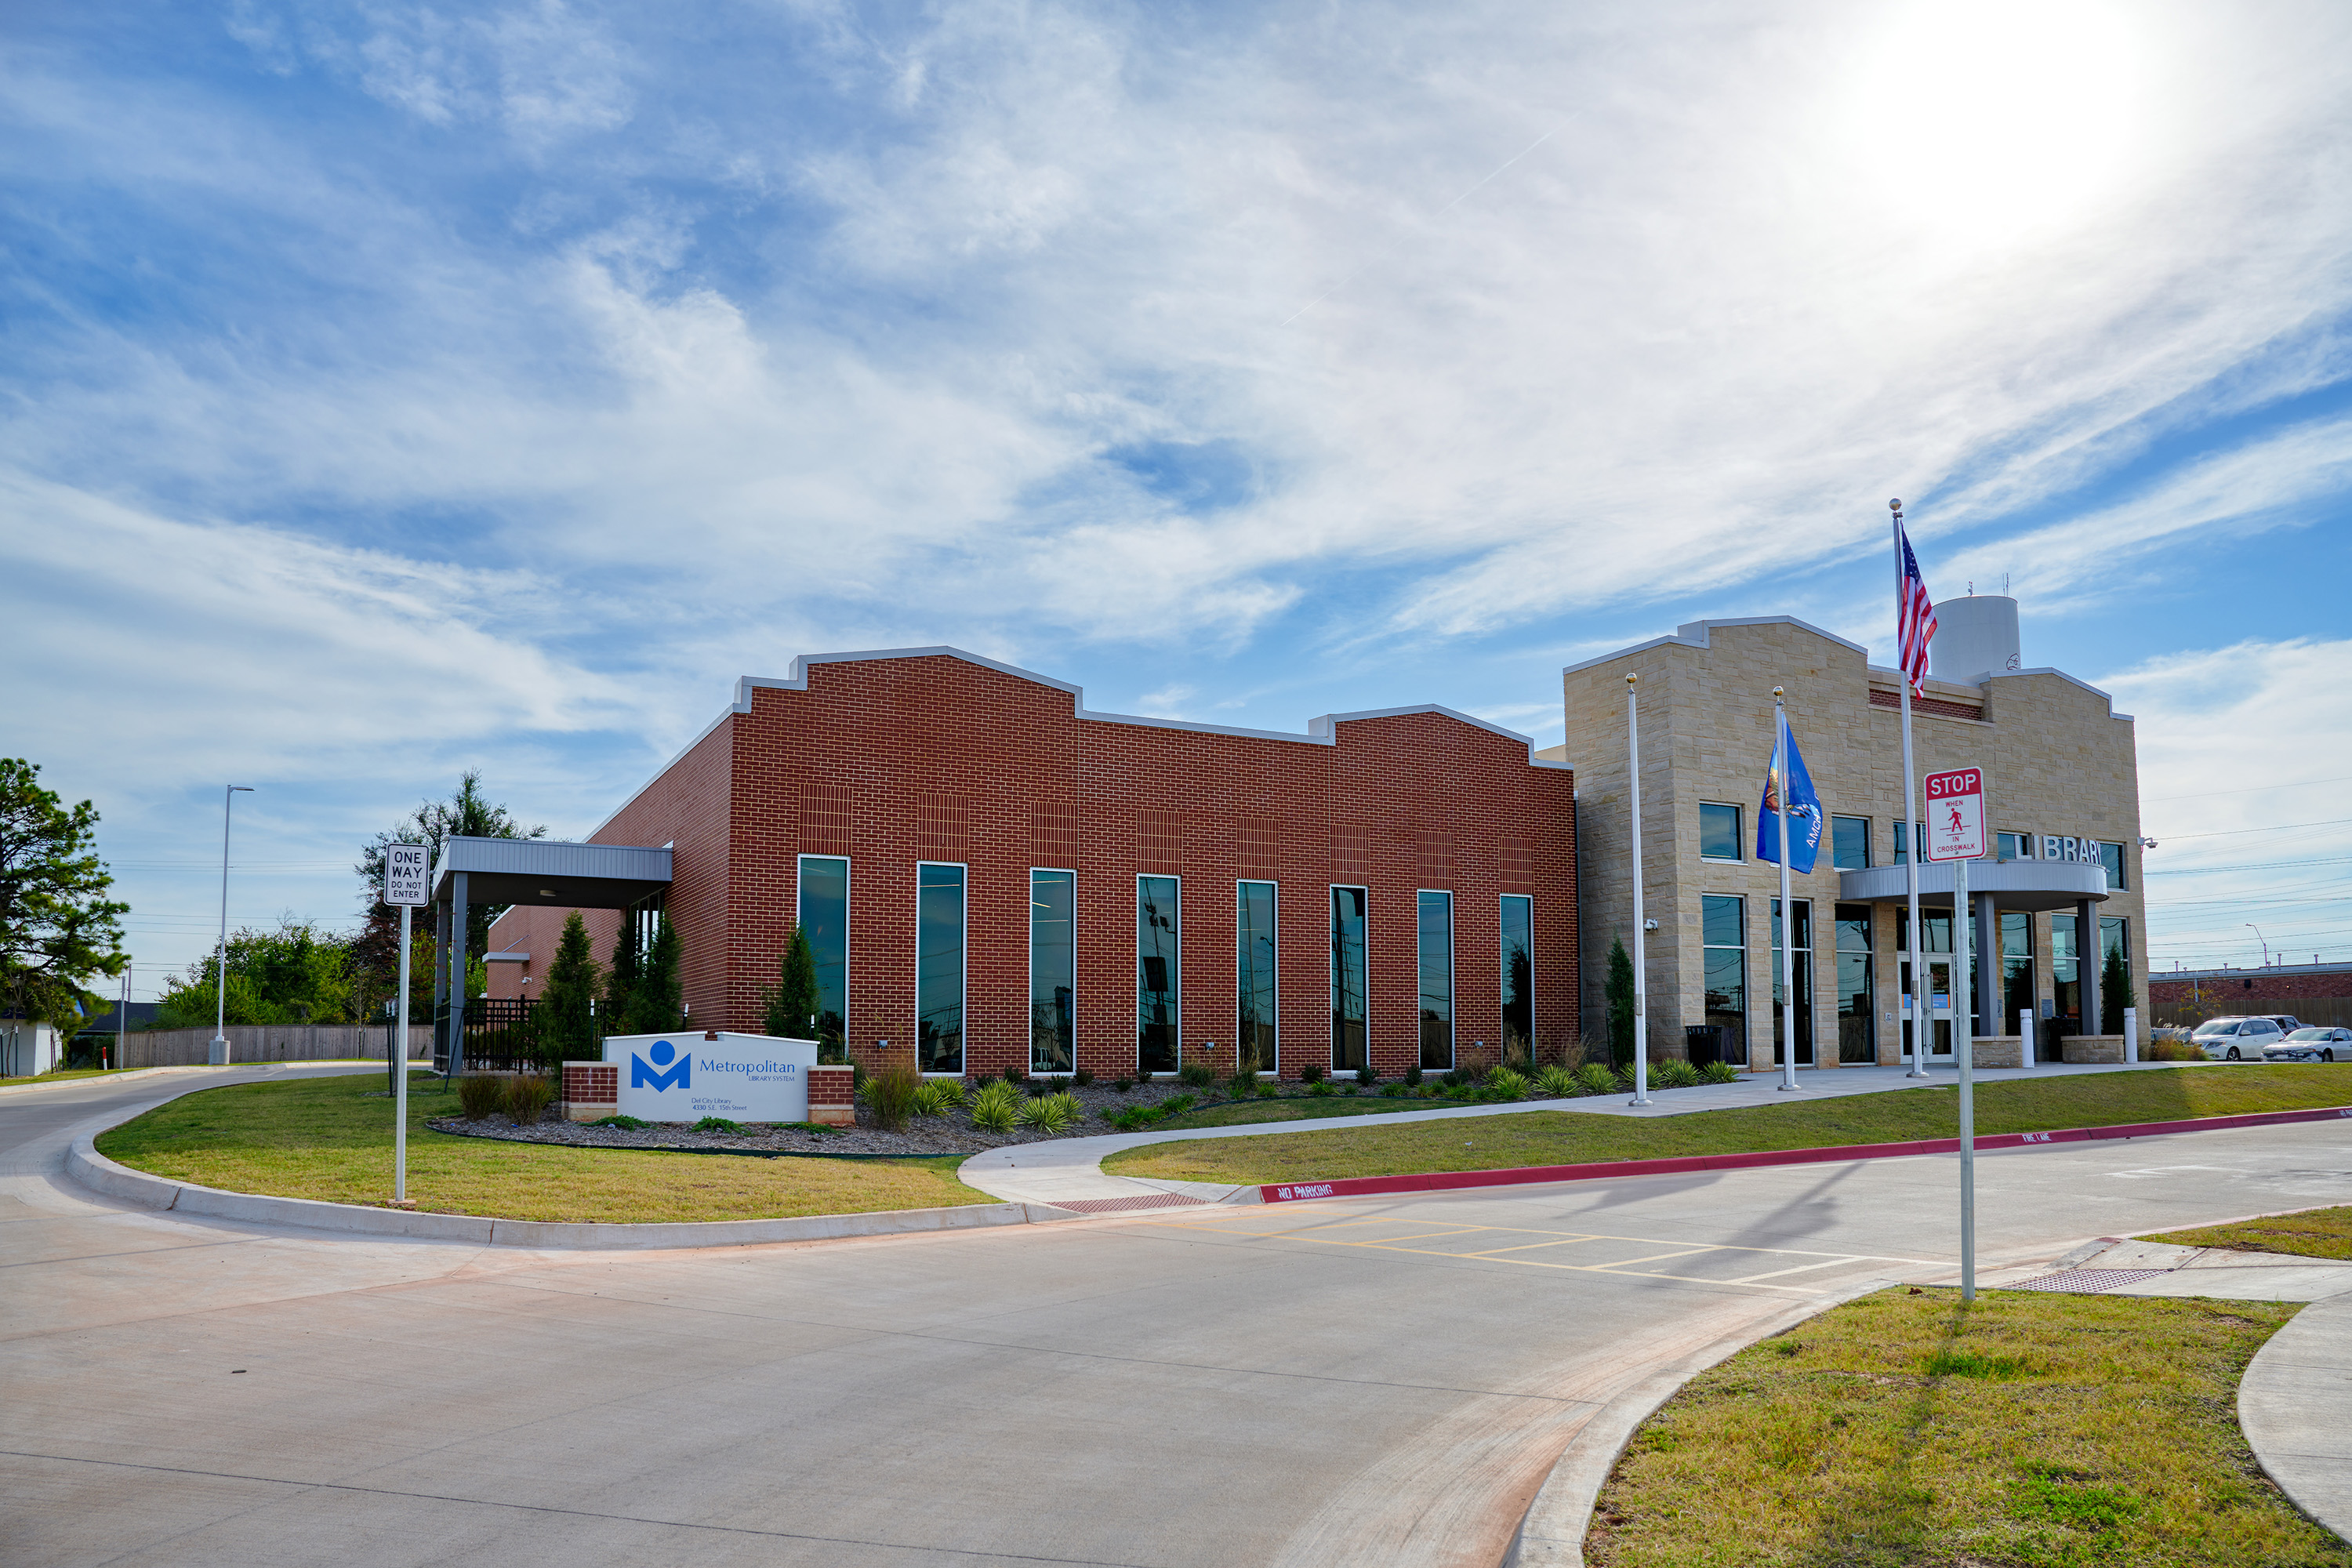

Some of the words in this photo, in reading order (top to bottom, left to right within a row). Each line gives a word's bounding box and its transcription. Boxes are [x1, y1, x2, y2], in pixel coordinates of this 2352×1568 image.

[1930, 774, 1976, 795] STOP
[1937, 843, 1975, 852] CROSSWALK
[2014, 835, 2101, 865] LIBRARY
[394, 851, 421, 863] ONE
[392, 866, 423, 878] WAY
[700, 1059, 795, 1076] Metropolitan
[1277, 1187, 1292, 1200] NO
[1294, 1184, 1333, 1199] PARKING
